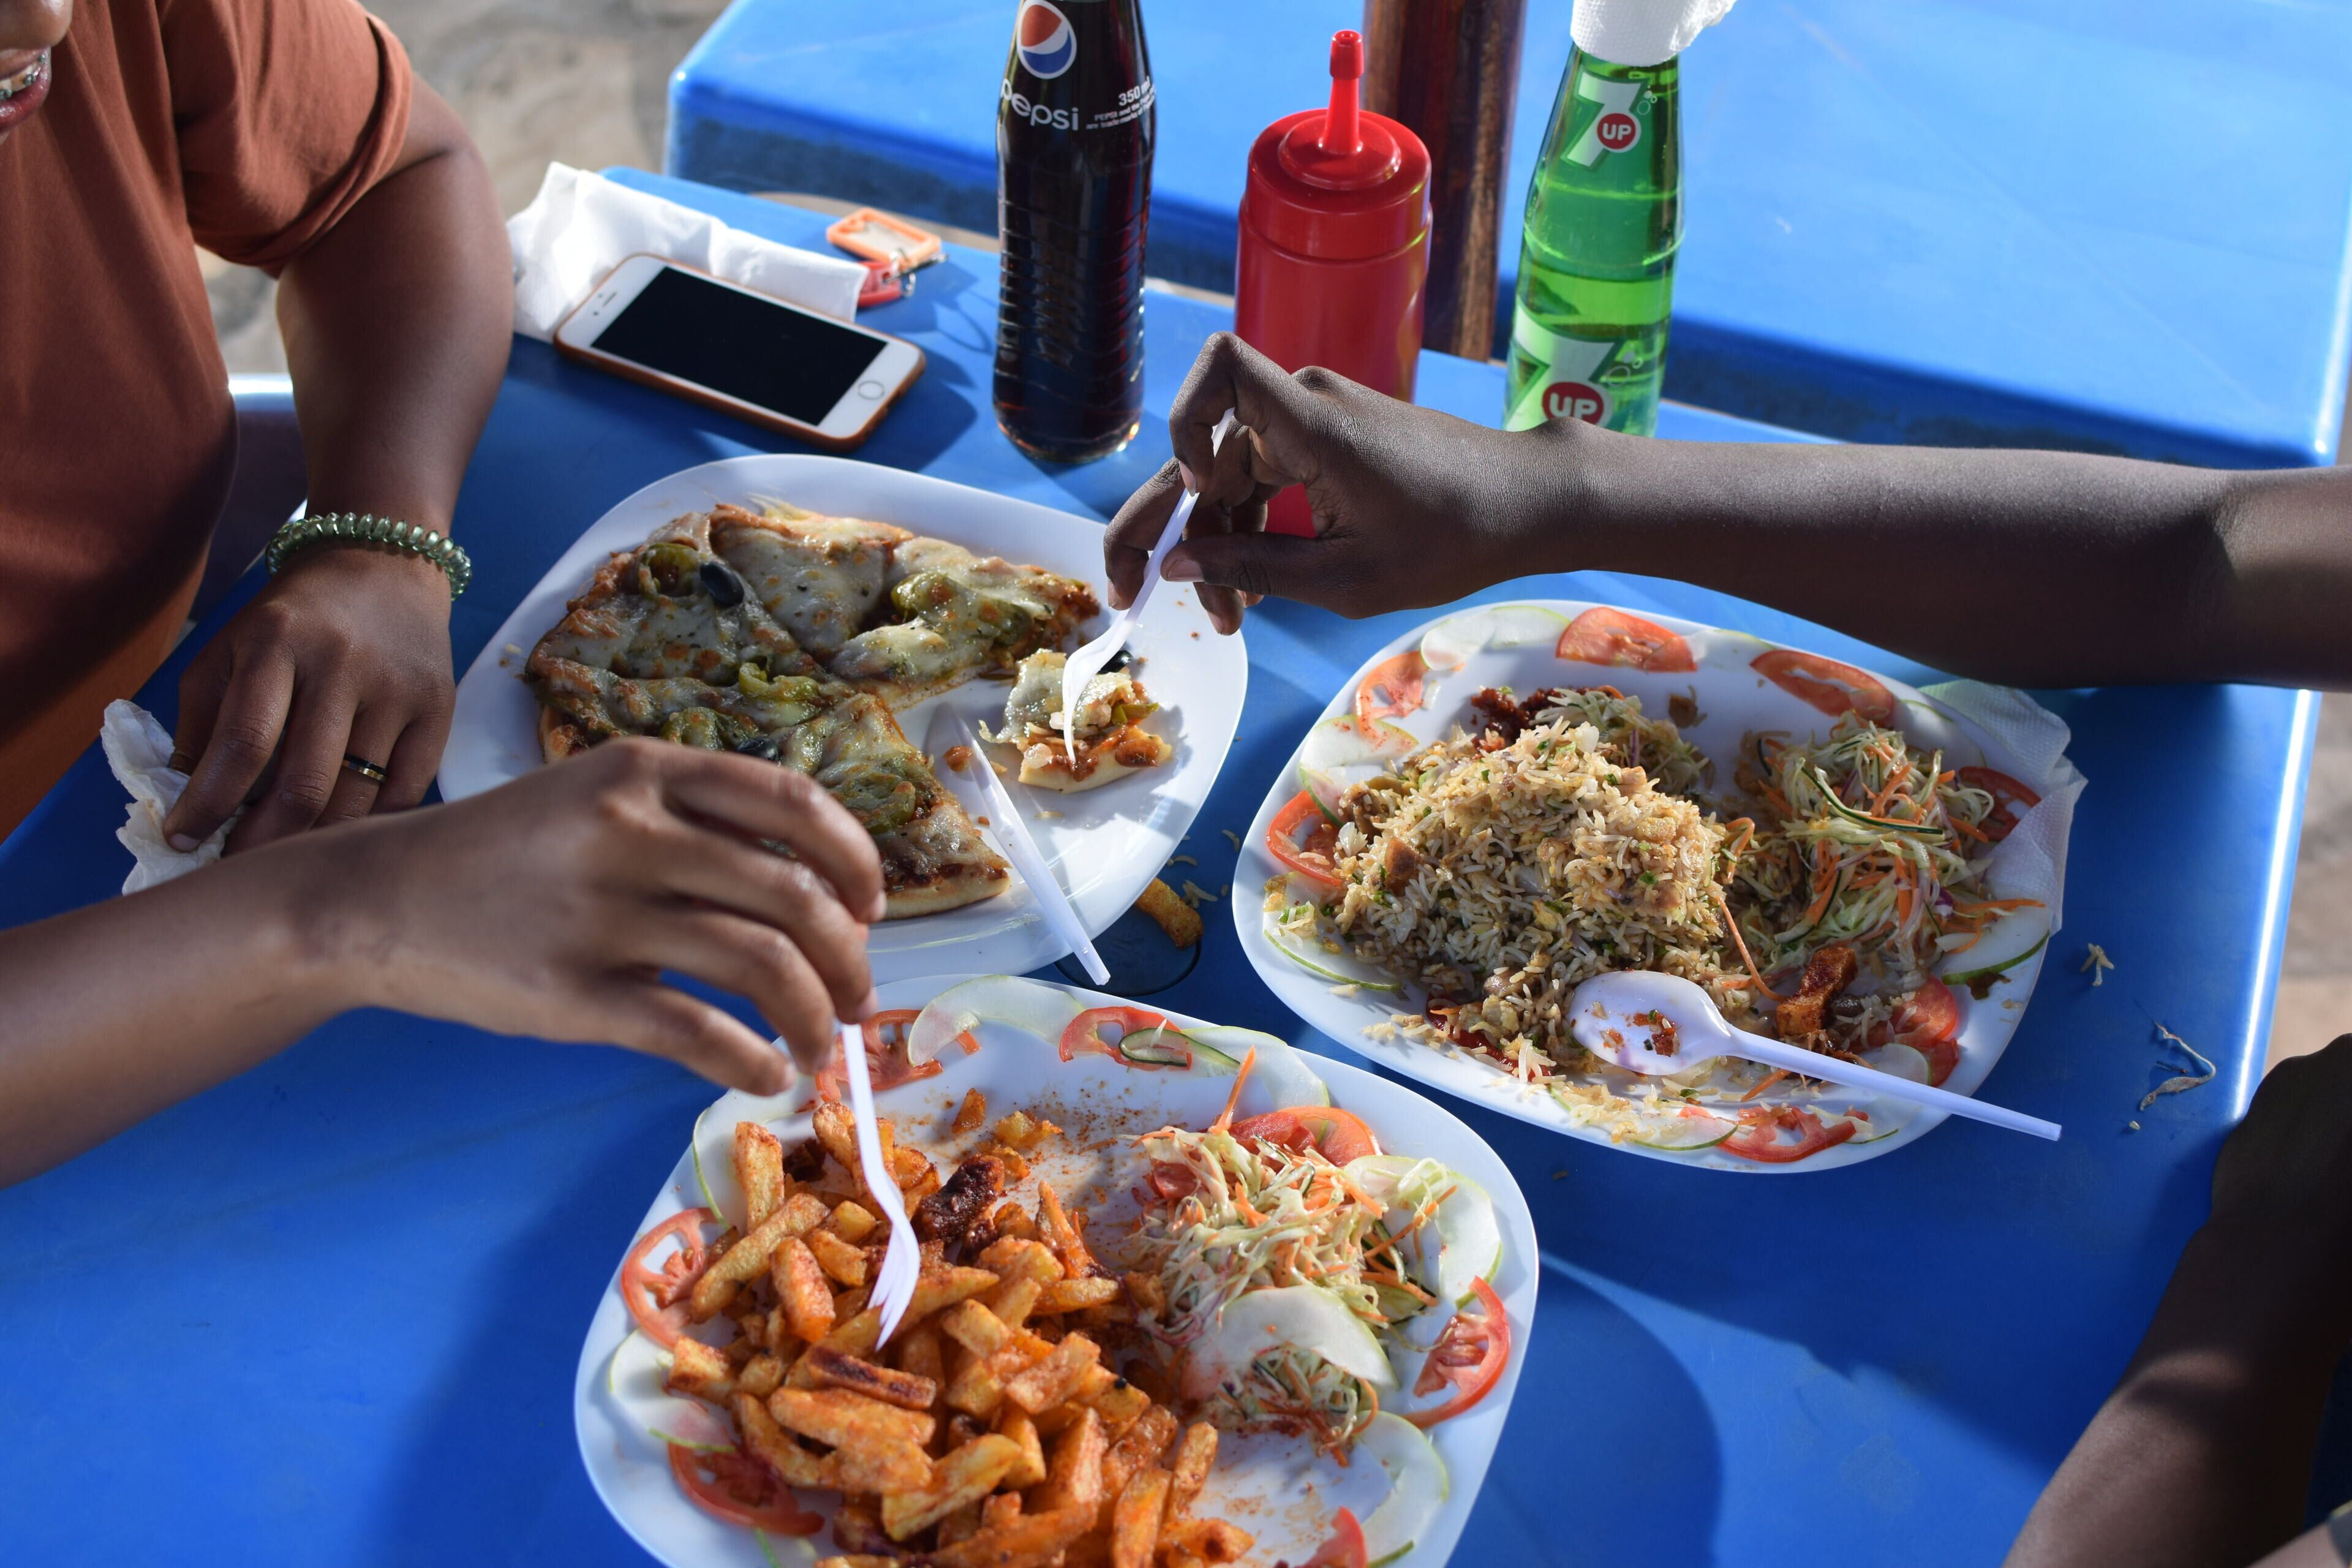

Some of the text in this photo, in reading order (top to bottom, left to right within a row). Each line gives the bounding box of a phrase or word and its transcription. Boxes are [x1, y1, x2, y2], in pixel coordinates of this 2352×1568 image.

[1000, 78, 1079, 131] pepsi
[1118, 86, 1140, 106] 350
[1566, 72, 1642, 167] 7 UP
[1506, 294, 1615, 432] 7 UP
